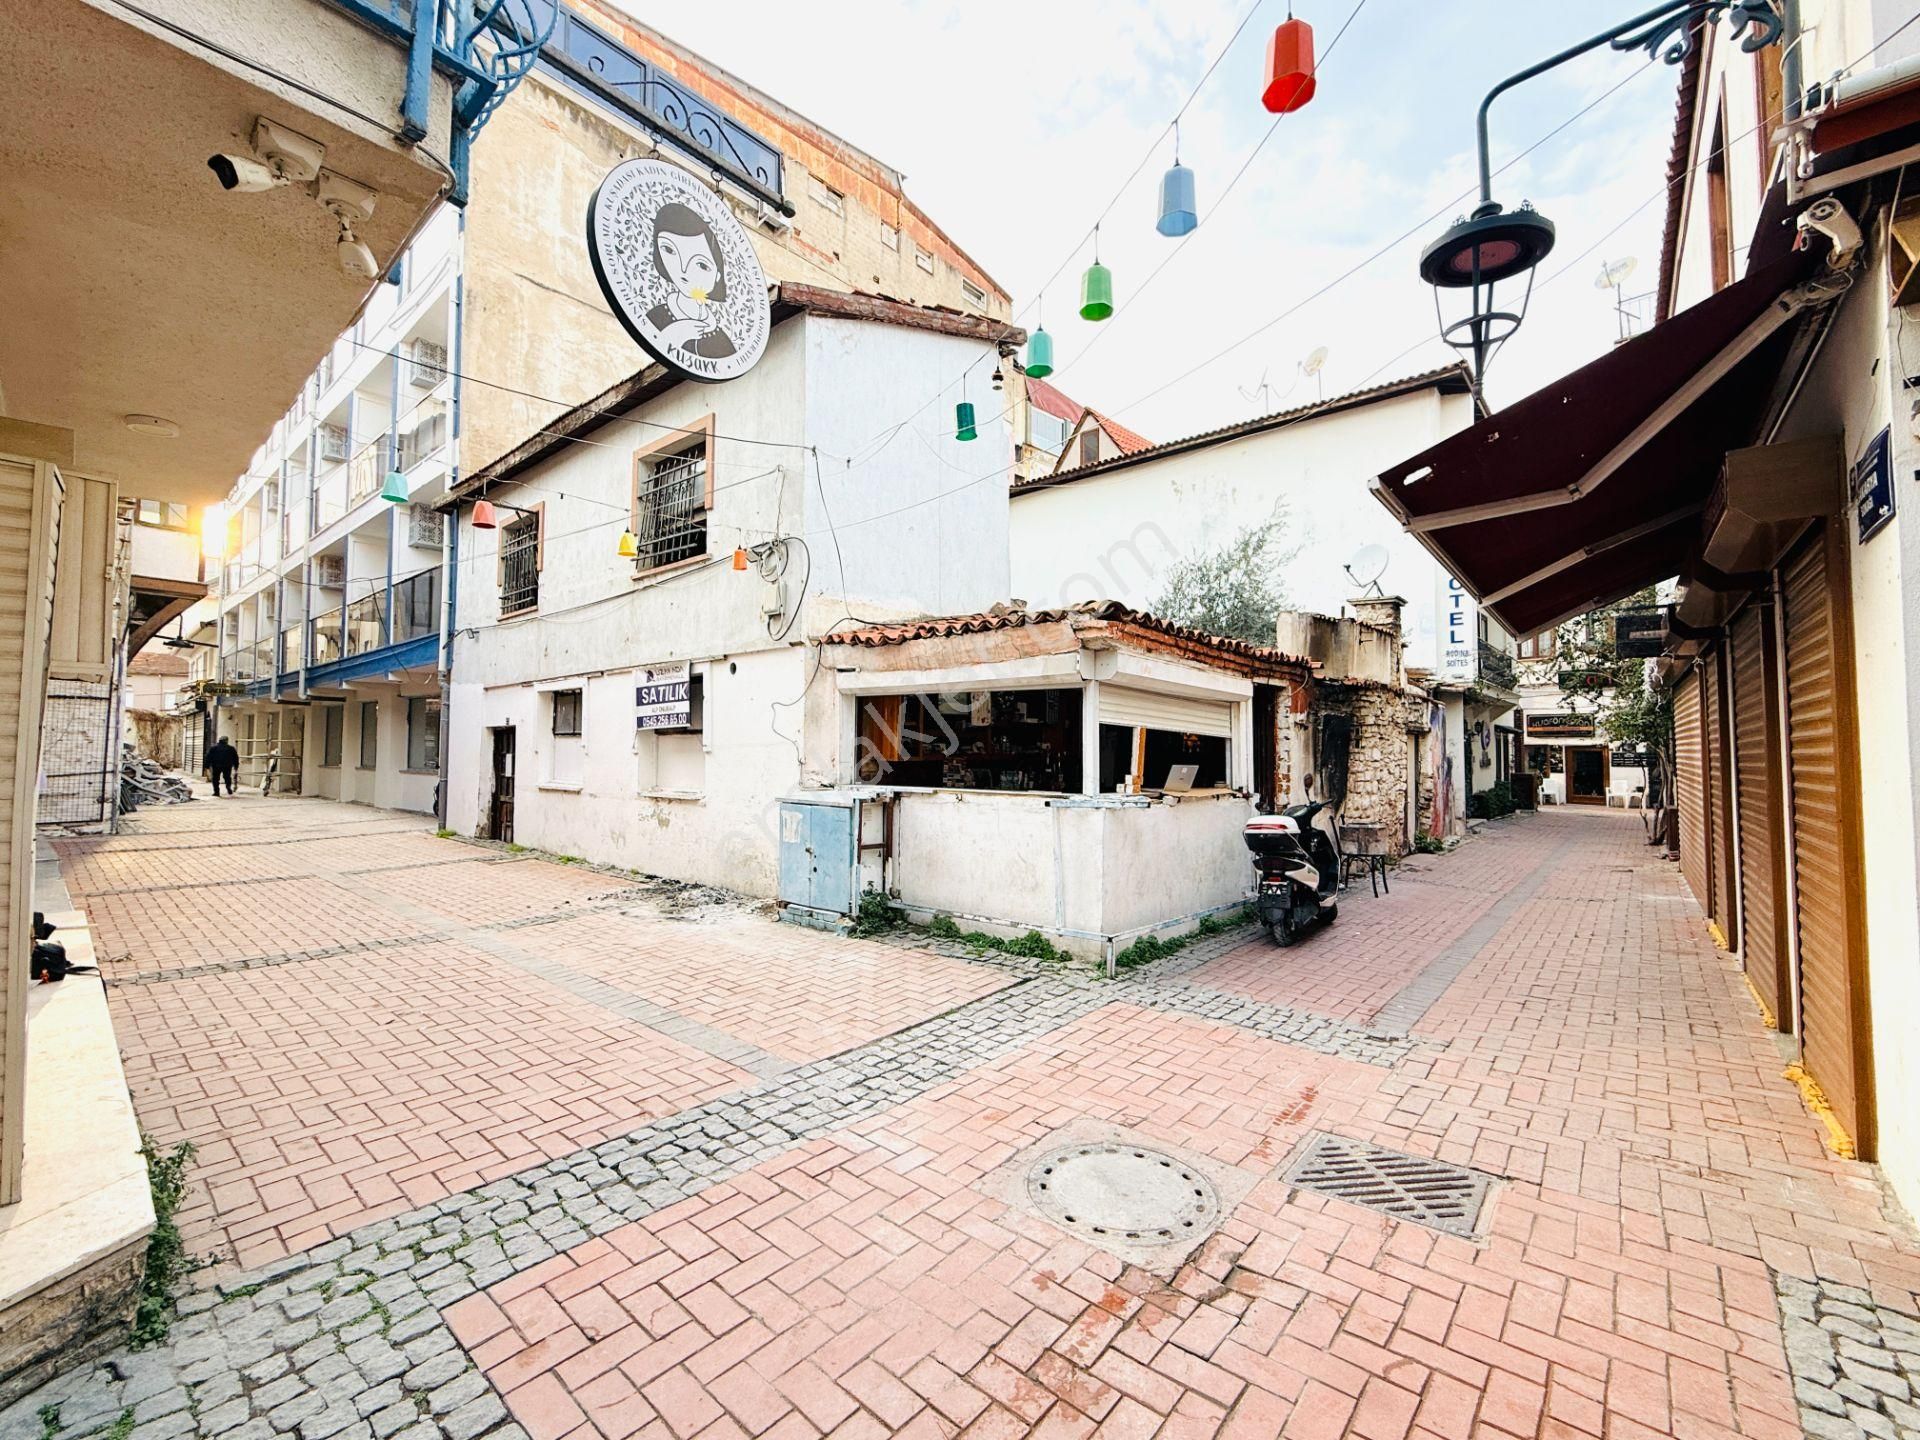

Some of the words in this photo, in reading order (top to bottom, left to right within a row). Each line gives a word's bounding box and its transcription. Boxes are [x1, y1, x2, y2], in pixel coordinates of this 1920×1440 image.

[635, 165, 667, 177] KADIN
[642, 684, 688, 704] SATILIK
[678, 713, 687, 724] 00
